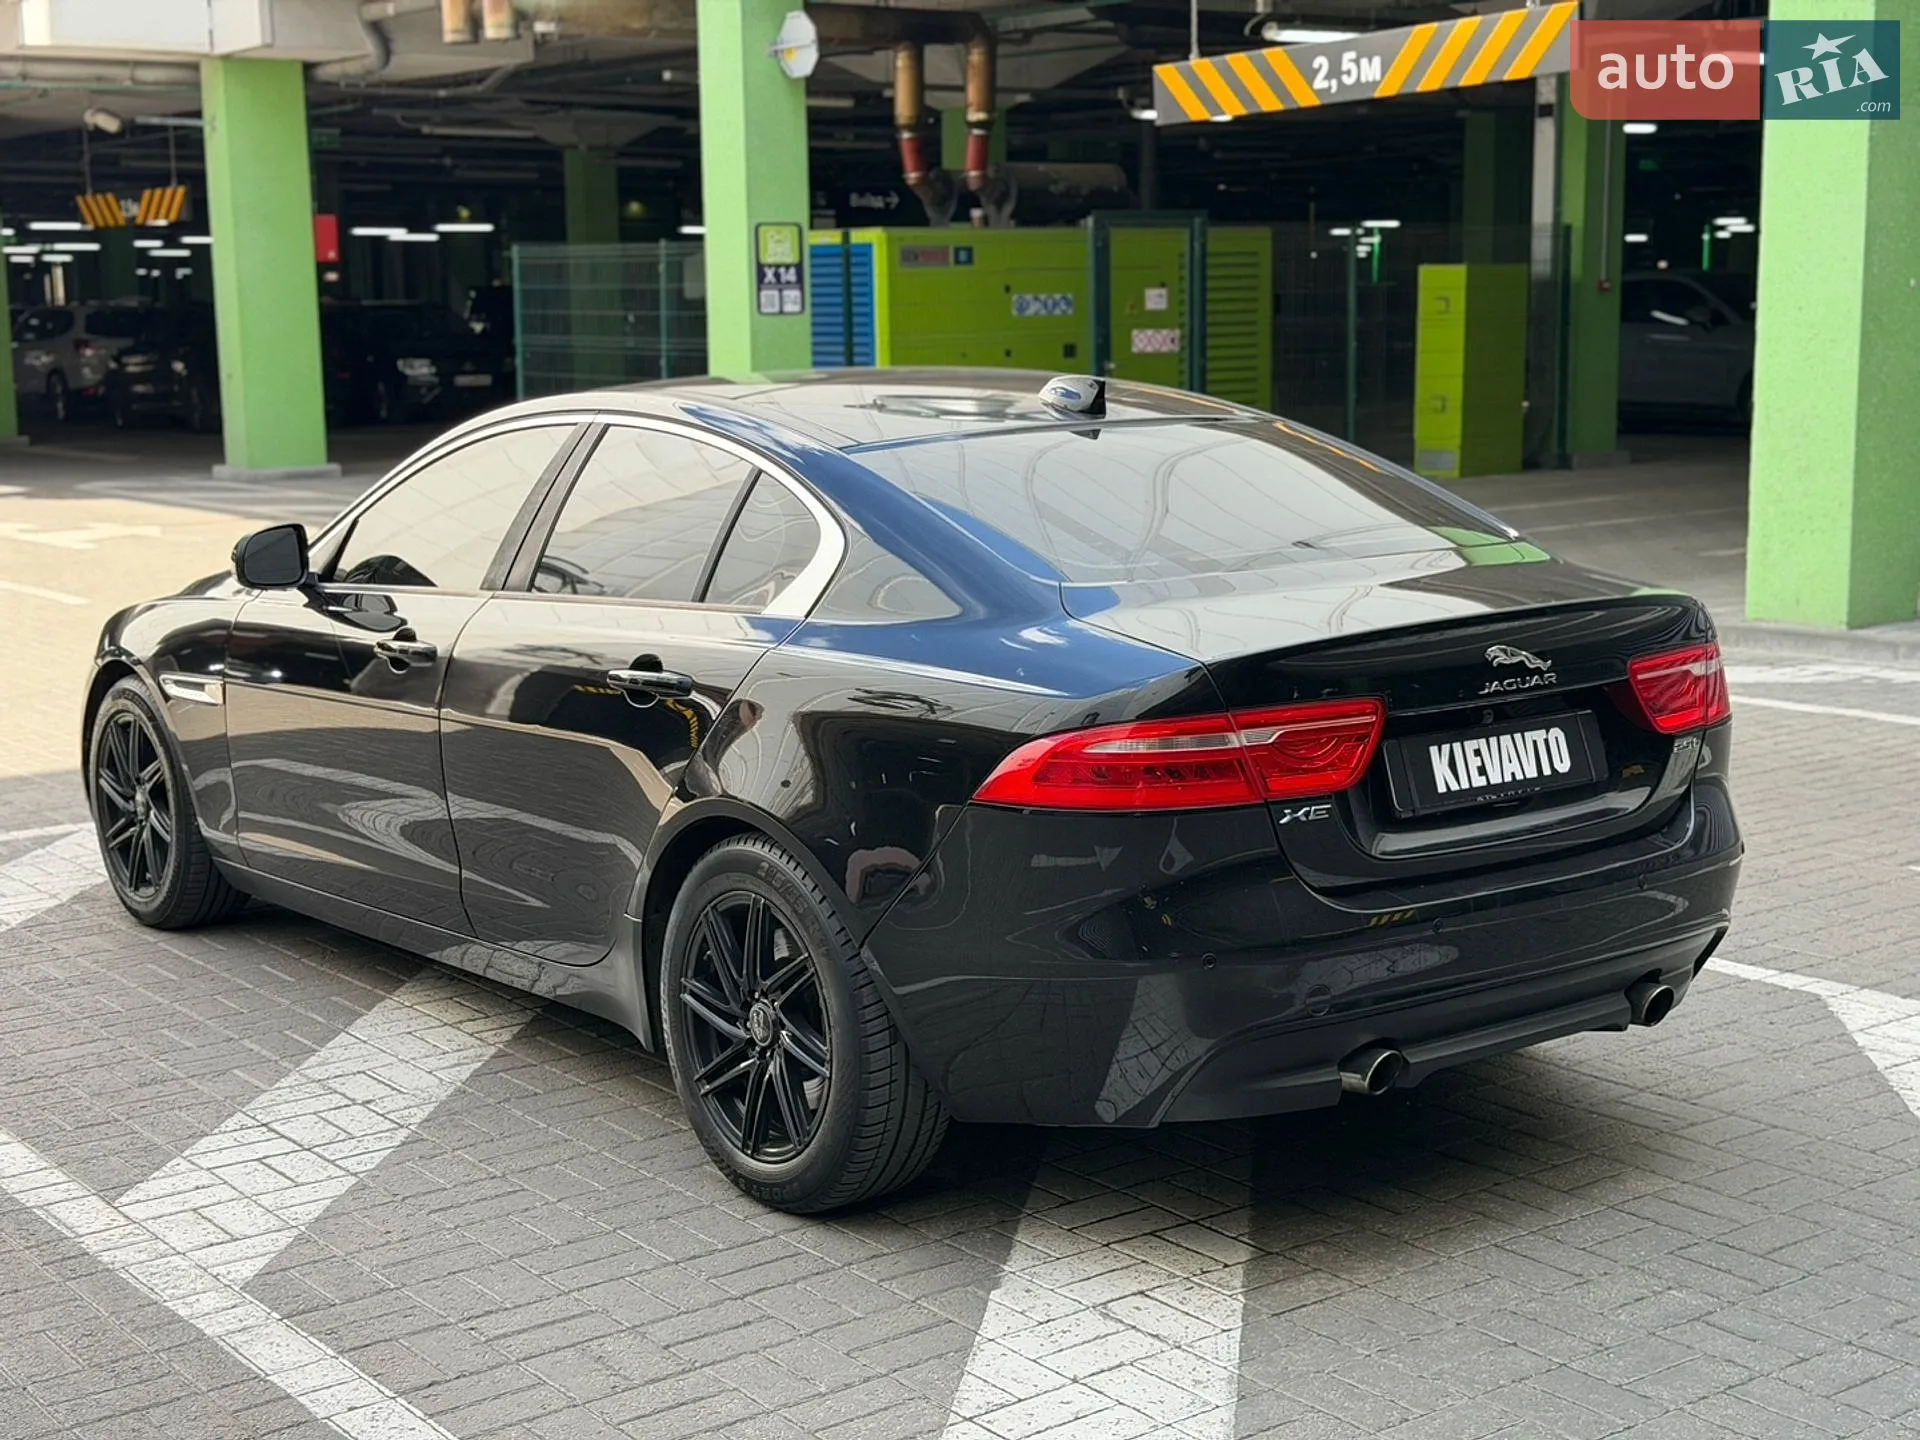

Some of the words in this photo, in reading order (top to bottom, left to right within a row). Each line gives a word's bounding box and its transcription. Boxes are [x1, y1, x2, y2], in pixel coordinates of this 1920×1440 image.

[1478, 673, 1557, 694] JAGUAR
[1428, 727, 1571, 794] KIEVAVTO
[1279, 804, 1332, 824] XE
